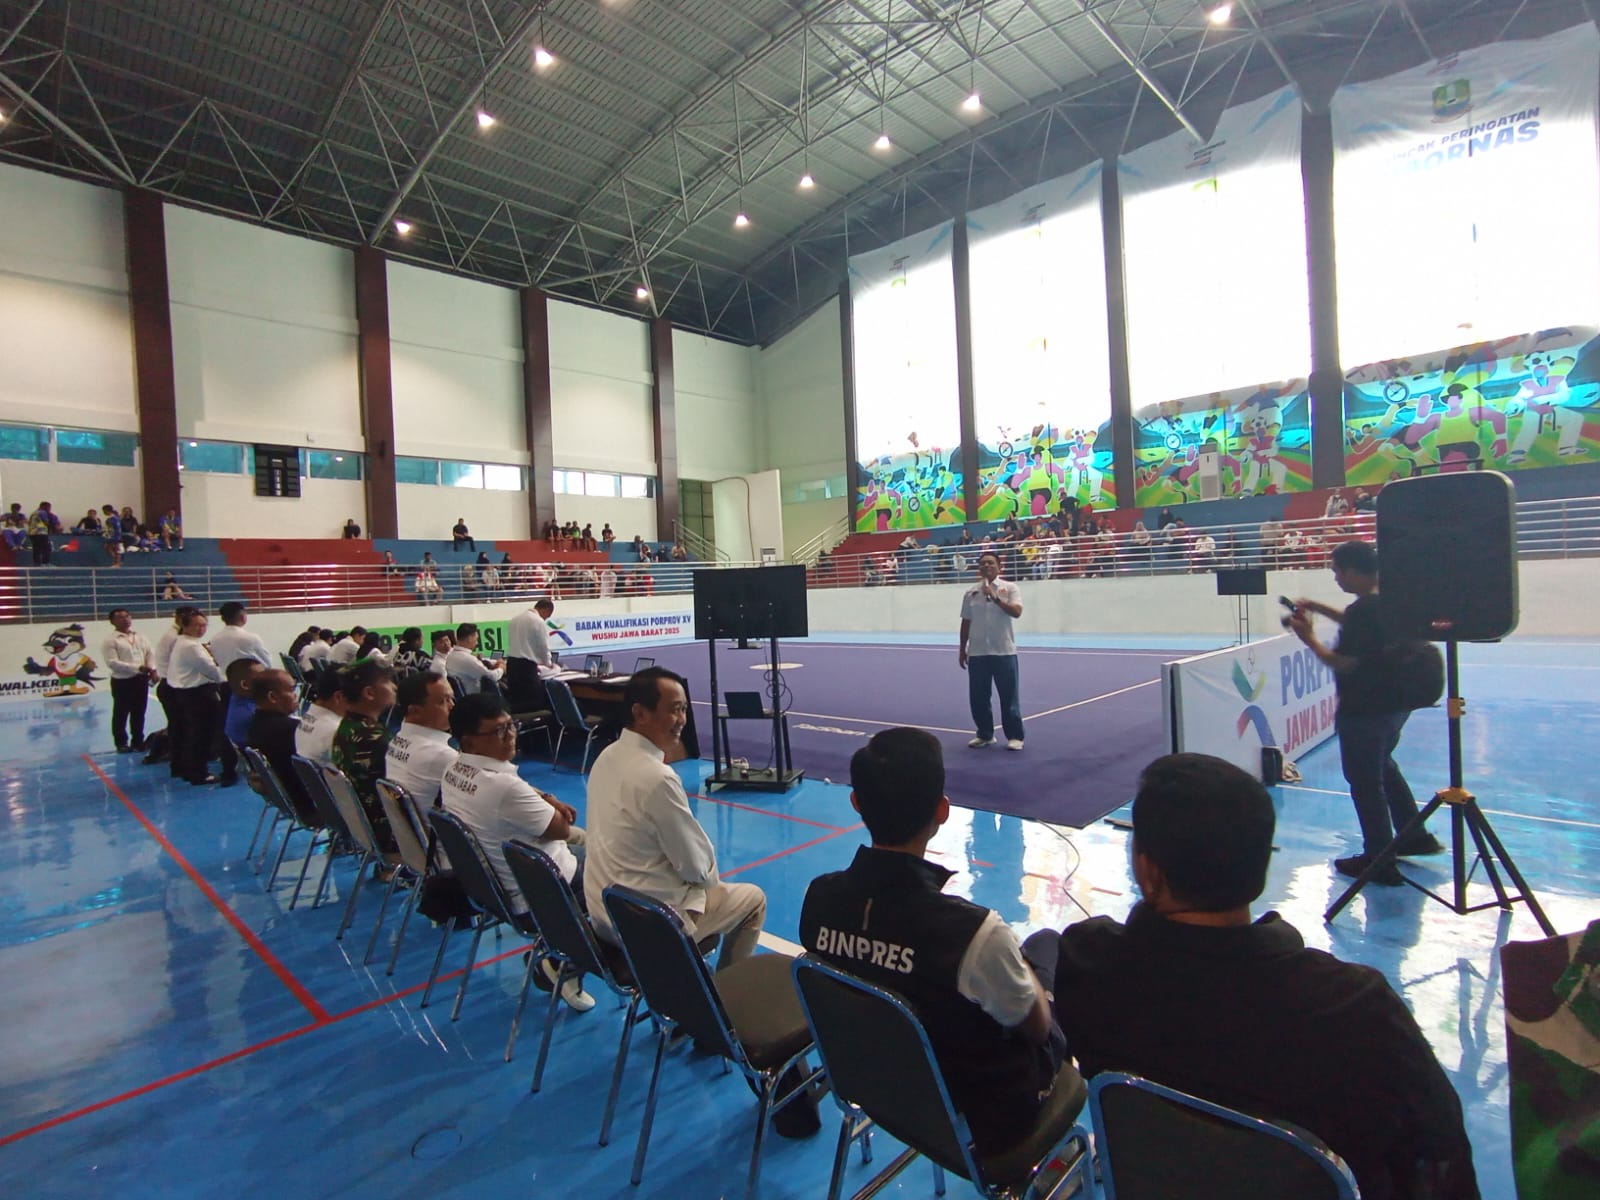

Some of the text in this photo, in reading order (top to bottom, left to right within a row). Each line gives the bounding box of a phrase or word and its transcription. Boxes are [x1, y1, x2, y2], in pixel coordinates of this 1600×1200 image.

[1441, 107, 1540, 145] PERINGATAN
[575, 615, 692, 631] BABAK KUALIFIKASI PORPROV XV
[592, 627, 680, 640] WUSHU JAWA BARAT 2025
[0, 679, 59, 691] WALKER
[1283, 706, 1318, 754] JAWA
[816, 926, 915, 974] BINPRES
